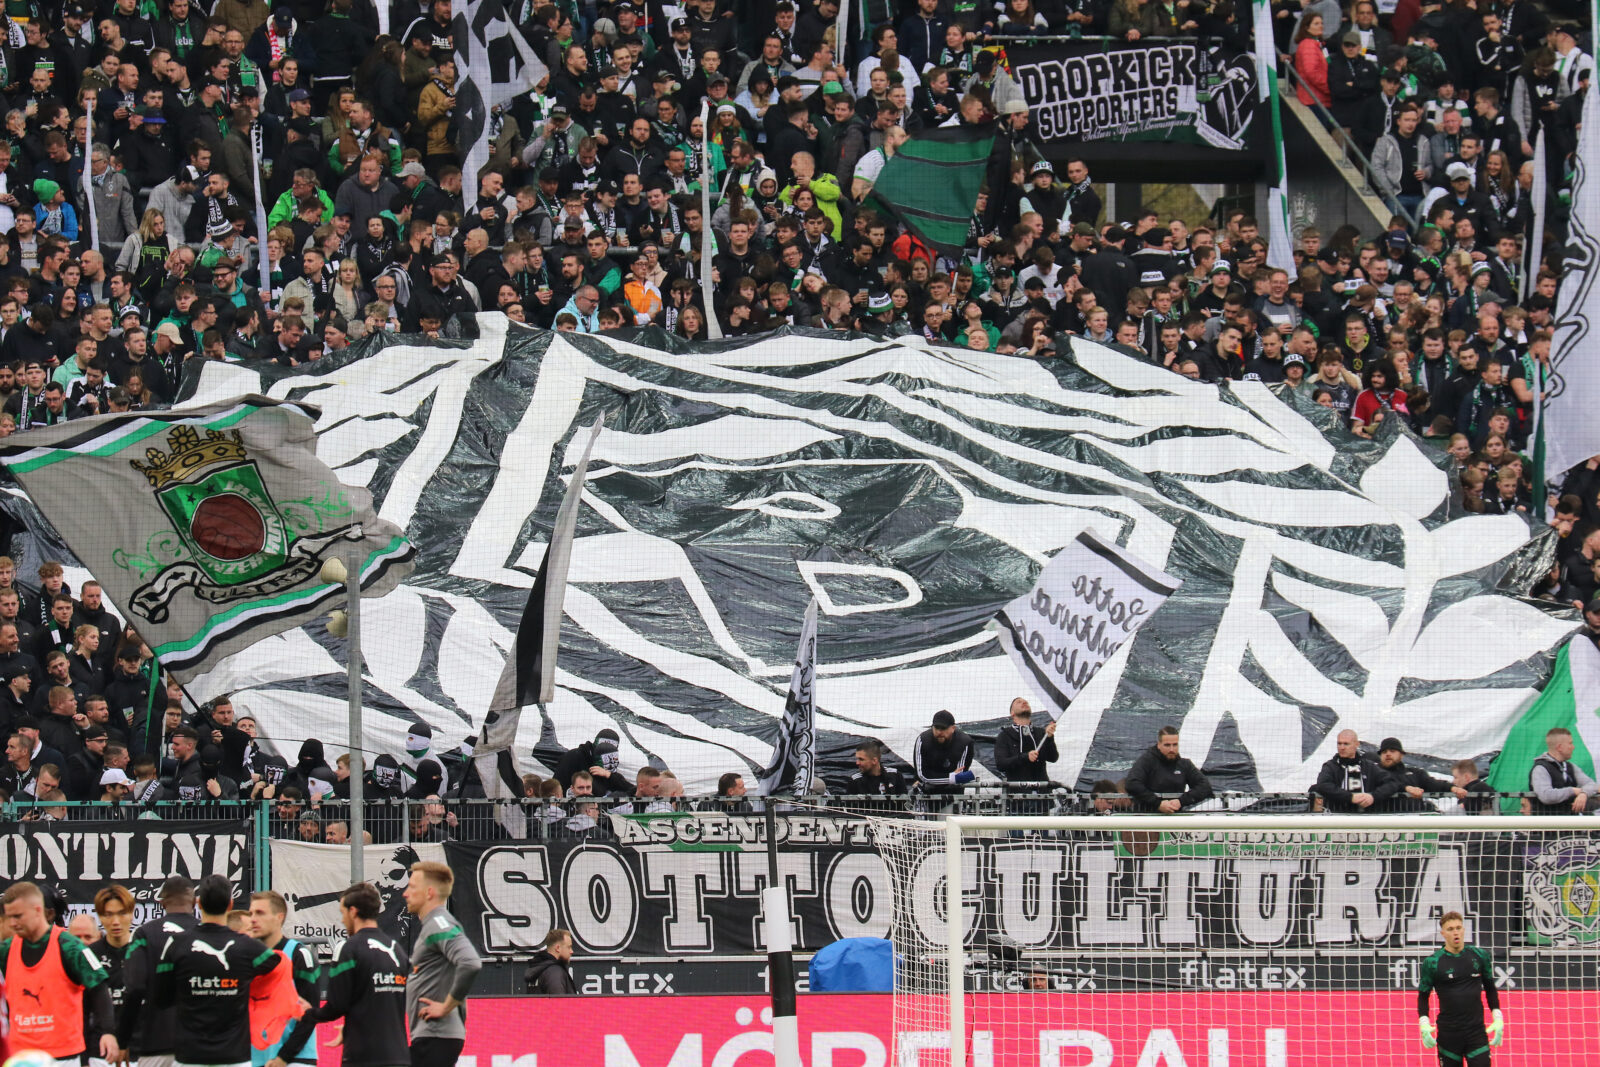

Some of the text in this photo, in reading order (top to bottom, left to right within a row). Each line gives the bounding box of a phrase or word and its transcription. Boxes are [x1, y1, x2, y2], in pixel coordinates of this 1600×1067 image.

[1017, 45, 1196, 107] DROPKICK
[1038, 87, 1179, 140] SUPPORTERS
[294, 923, 349, 939] rabauke
[189, 976, 239, 988] flatex
[373, 973, 408, 985] flatex
[577, 966, 676, 995] atex
[1178, 960, 1307, 989] flatex
